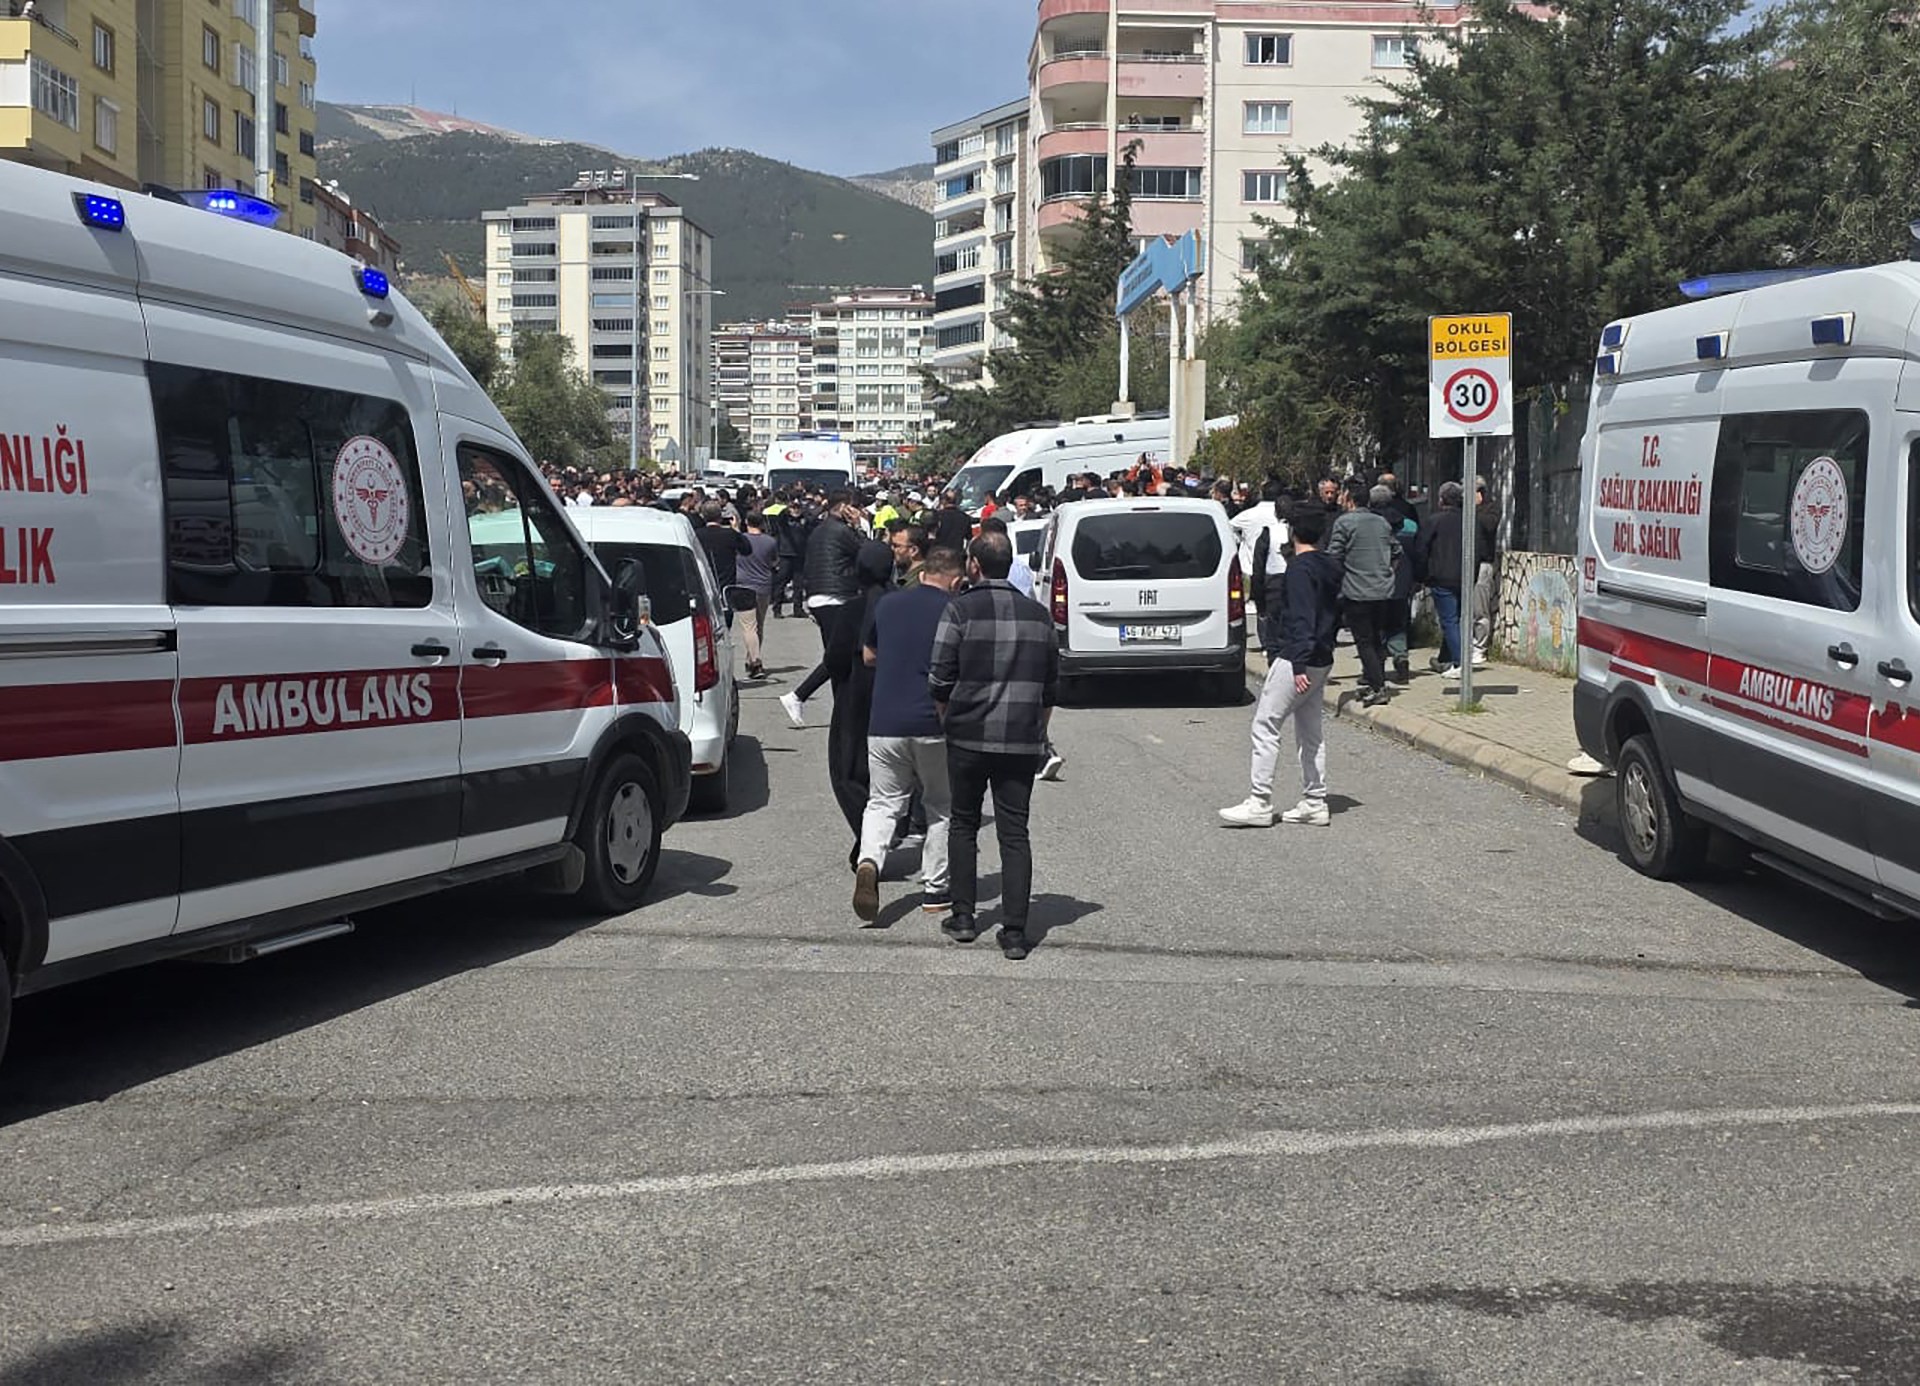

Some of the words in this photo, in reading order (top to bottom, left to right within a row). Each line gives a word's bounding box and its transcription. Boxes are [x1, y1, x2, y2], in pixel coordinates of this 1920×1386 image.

[1435, 336, 1506, 353] BÖLGESİ
[1447, 323, 1493, 335] OKUL
[1456, 383, 1486, 407] 30
[0, 423, 88, 494] NLIĞI
[1642, 435, 1661, 467] T.C.
[1600, 473, 1635, 510] SAĞLIK
[1638, 472, 1702, 515] BAKANLIĞI
[1613, 516, 1636, 554] ACİL
[1639, 519, 1681, 560] SAĞLIK
[1139, 589, 1159, 605] FIAT
[212, 673, 433, 734] AMBULANS
[1740, 667, 1834, 720] AMBULANS
